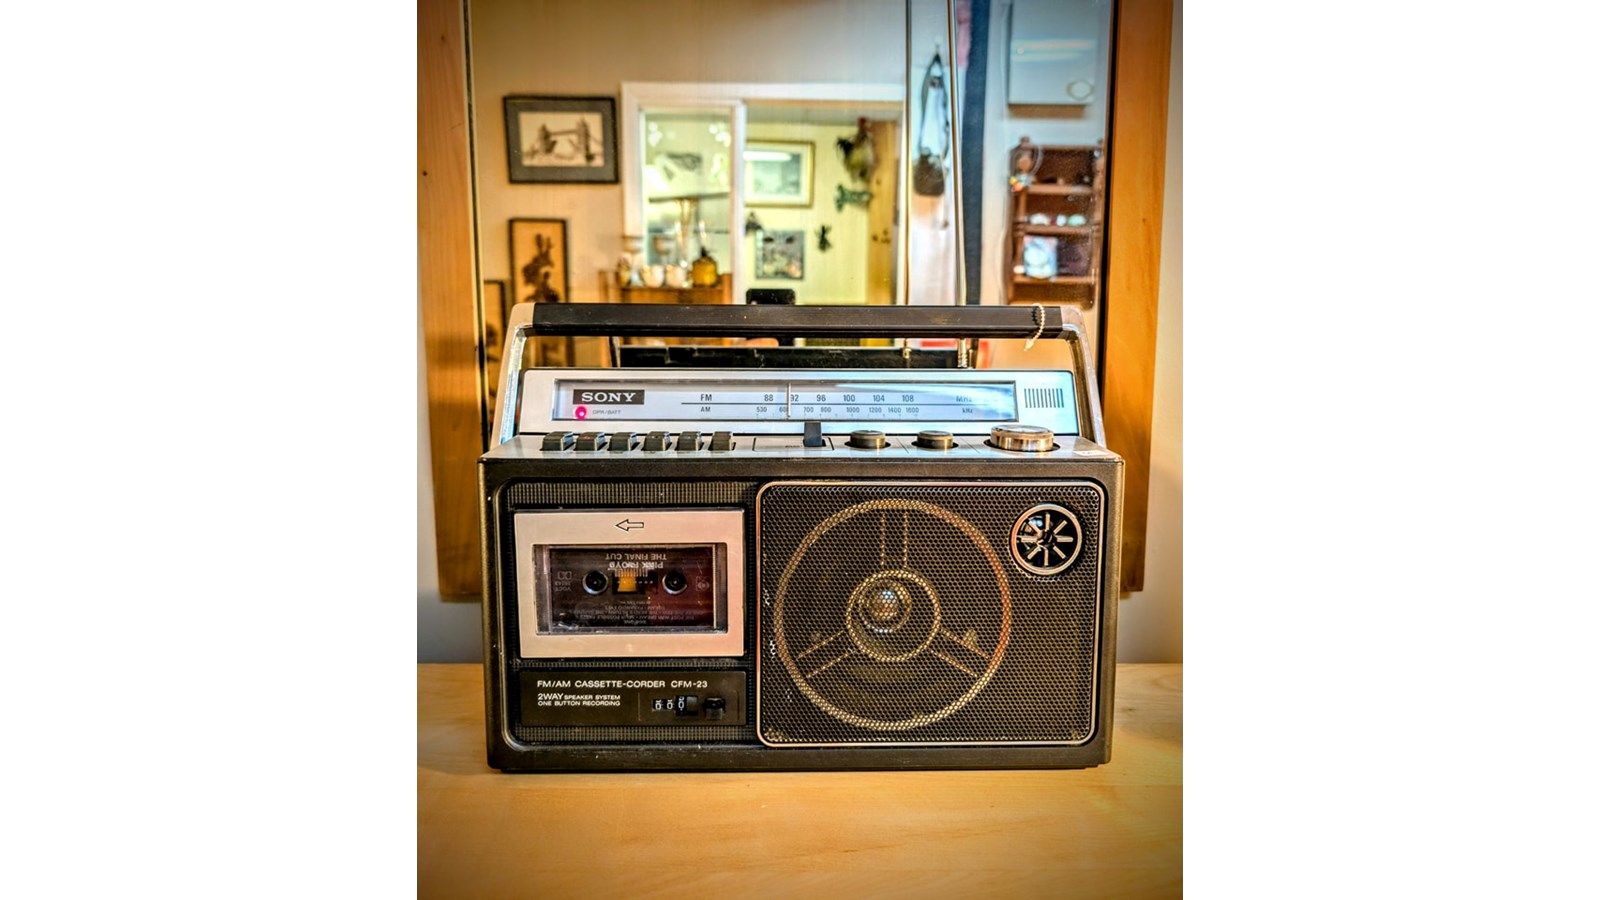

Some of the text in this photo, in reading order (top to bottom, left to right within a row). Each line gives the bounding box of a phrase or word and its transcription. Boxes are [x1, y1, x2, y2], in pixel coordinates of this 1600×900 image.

[581, 392, 636, 403] SONY
[700, 393, 712, 402] FM
[764, 393, 774, 402] 88
[790, 393, 799, 402] 92
[816, 393, 826, 402] 96
[843, 393, 856, 402] 100
[873, 394, 885, 403] 104
[902, 394, 914, 403] 108
[604, 553, 667, 561] THE FINAL CUT
[537, 680, 708, 688] FM/AM CASSETTE-CORDER CFM-23
[537, 692, 564, 700] 2WAY
